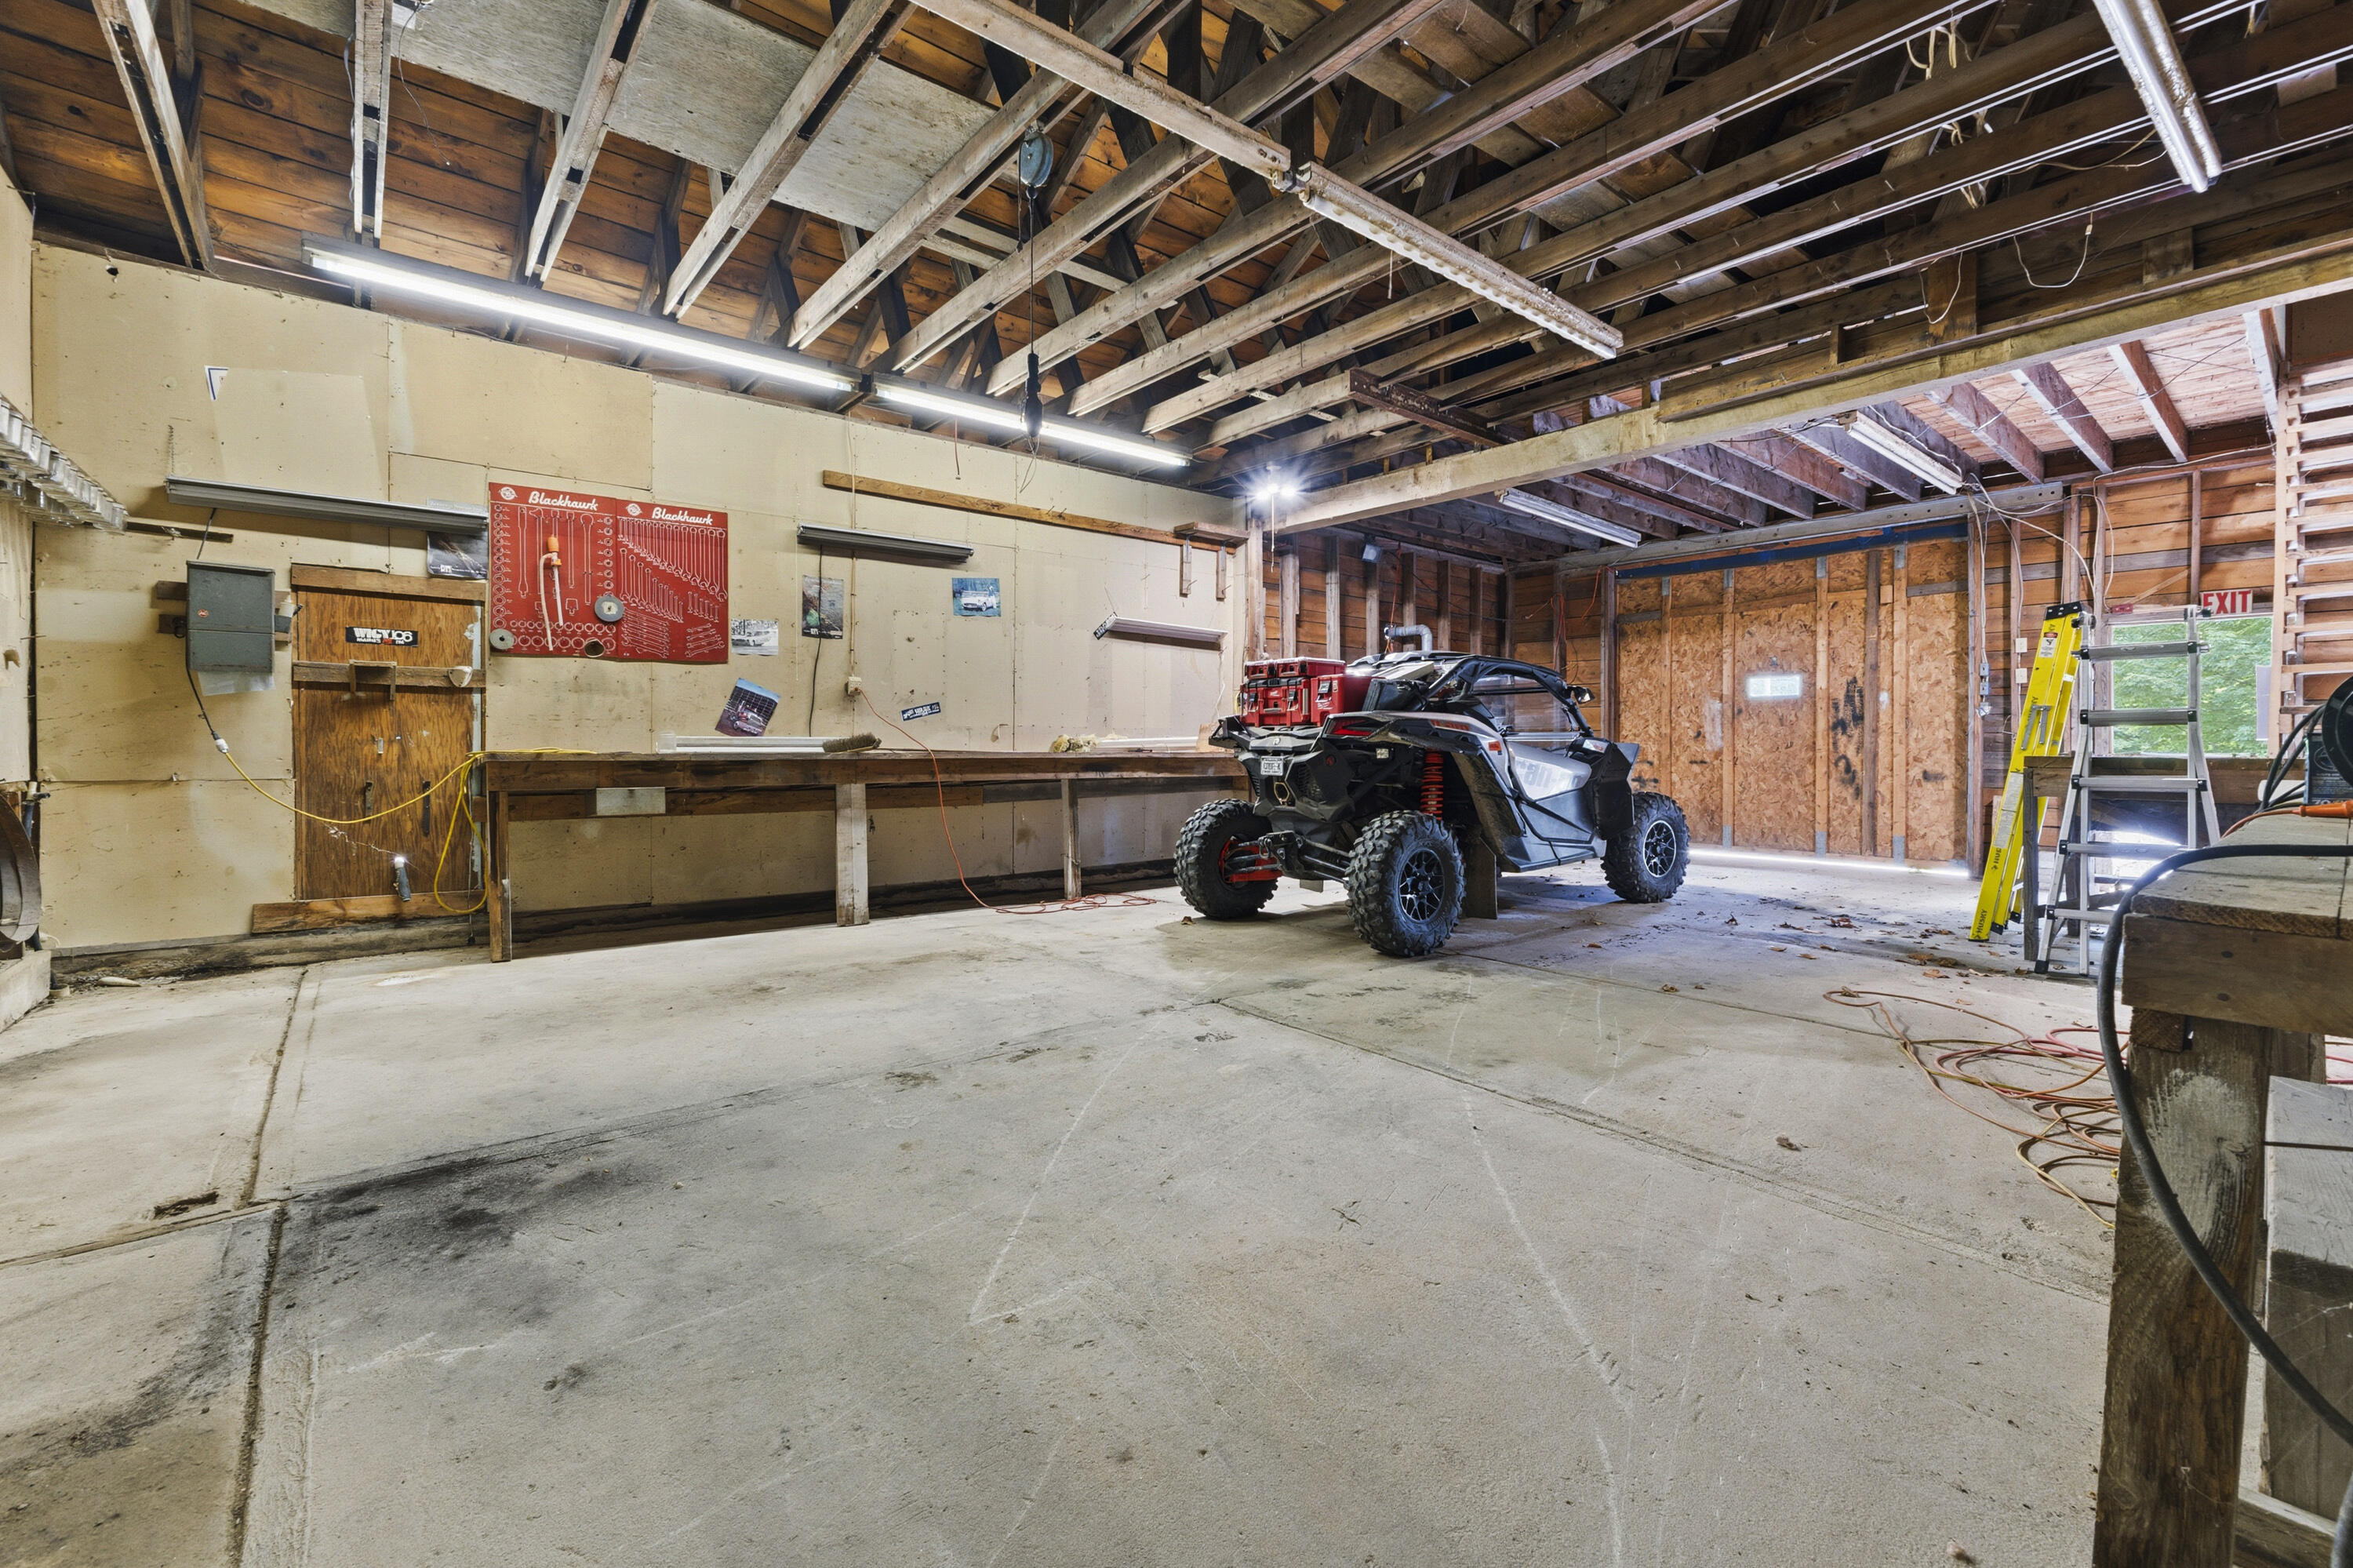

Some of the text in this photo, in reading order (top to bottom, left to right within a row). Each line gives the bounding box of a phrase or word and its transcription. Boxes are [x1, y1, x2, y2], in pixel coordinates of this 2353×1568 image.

[528, 490, 598, 511] Blackhawk
[652, 506, 714, 526] Blackhawk
[2202, 589, 2252, 615] EXIT
[1975, 908, 1988, 933] HUSKY
